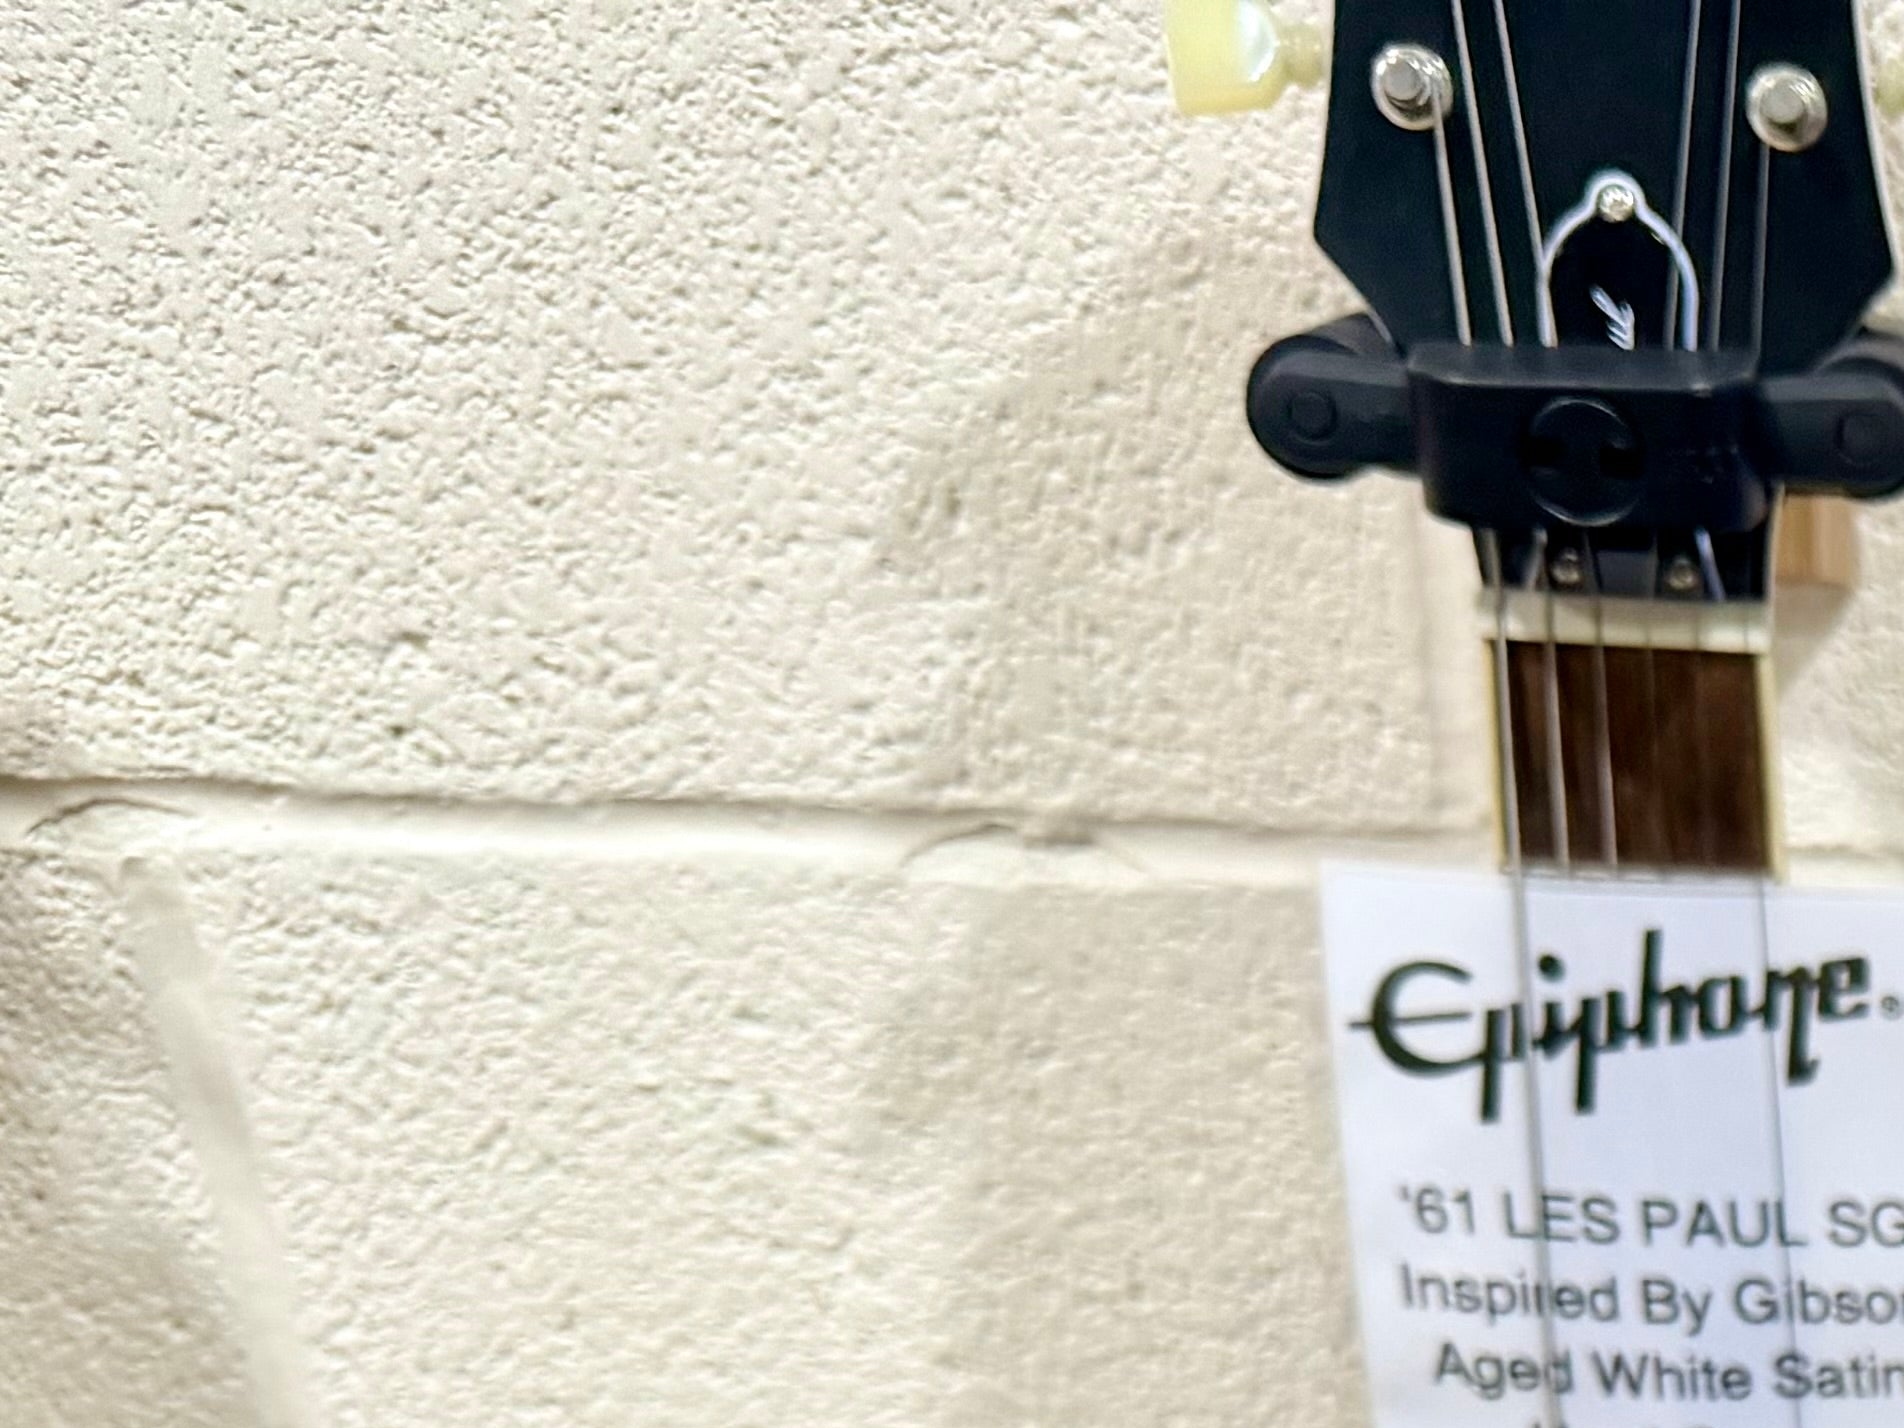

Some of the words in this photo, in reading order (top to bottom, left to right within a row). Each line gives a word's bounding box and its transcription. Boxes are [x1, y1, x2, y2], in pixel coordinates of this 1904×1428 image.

[1349, 928, 1870, 1123] Epiphone
[1503, 1192, 1620, 1244] LES
[1640, 1198, 1808, 1248] PAUL
[1398, 1264, 1619, 1326] Inspired
[1640, 1277, 1713, 1336] By
[1433, 1342, 1573, 1401] Aged
[1591, 1352, 1753, 1400] White
